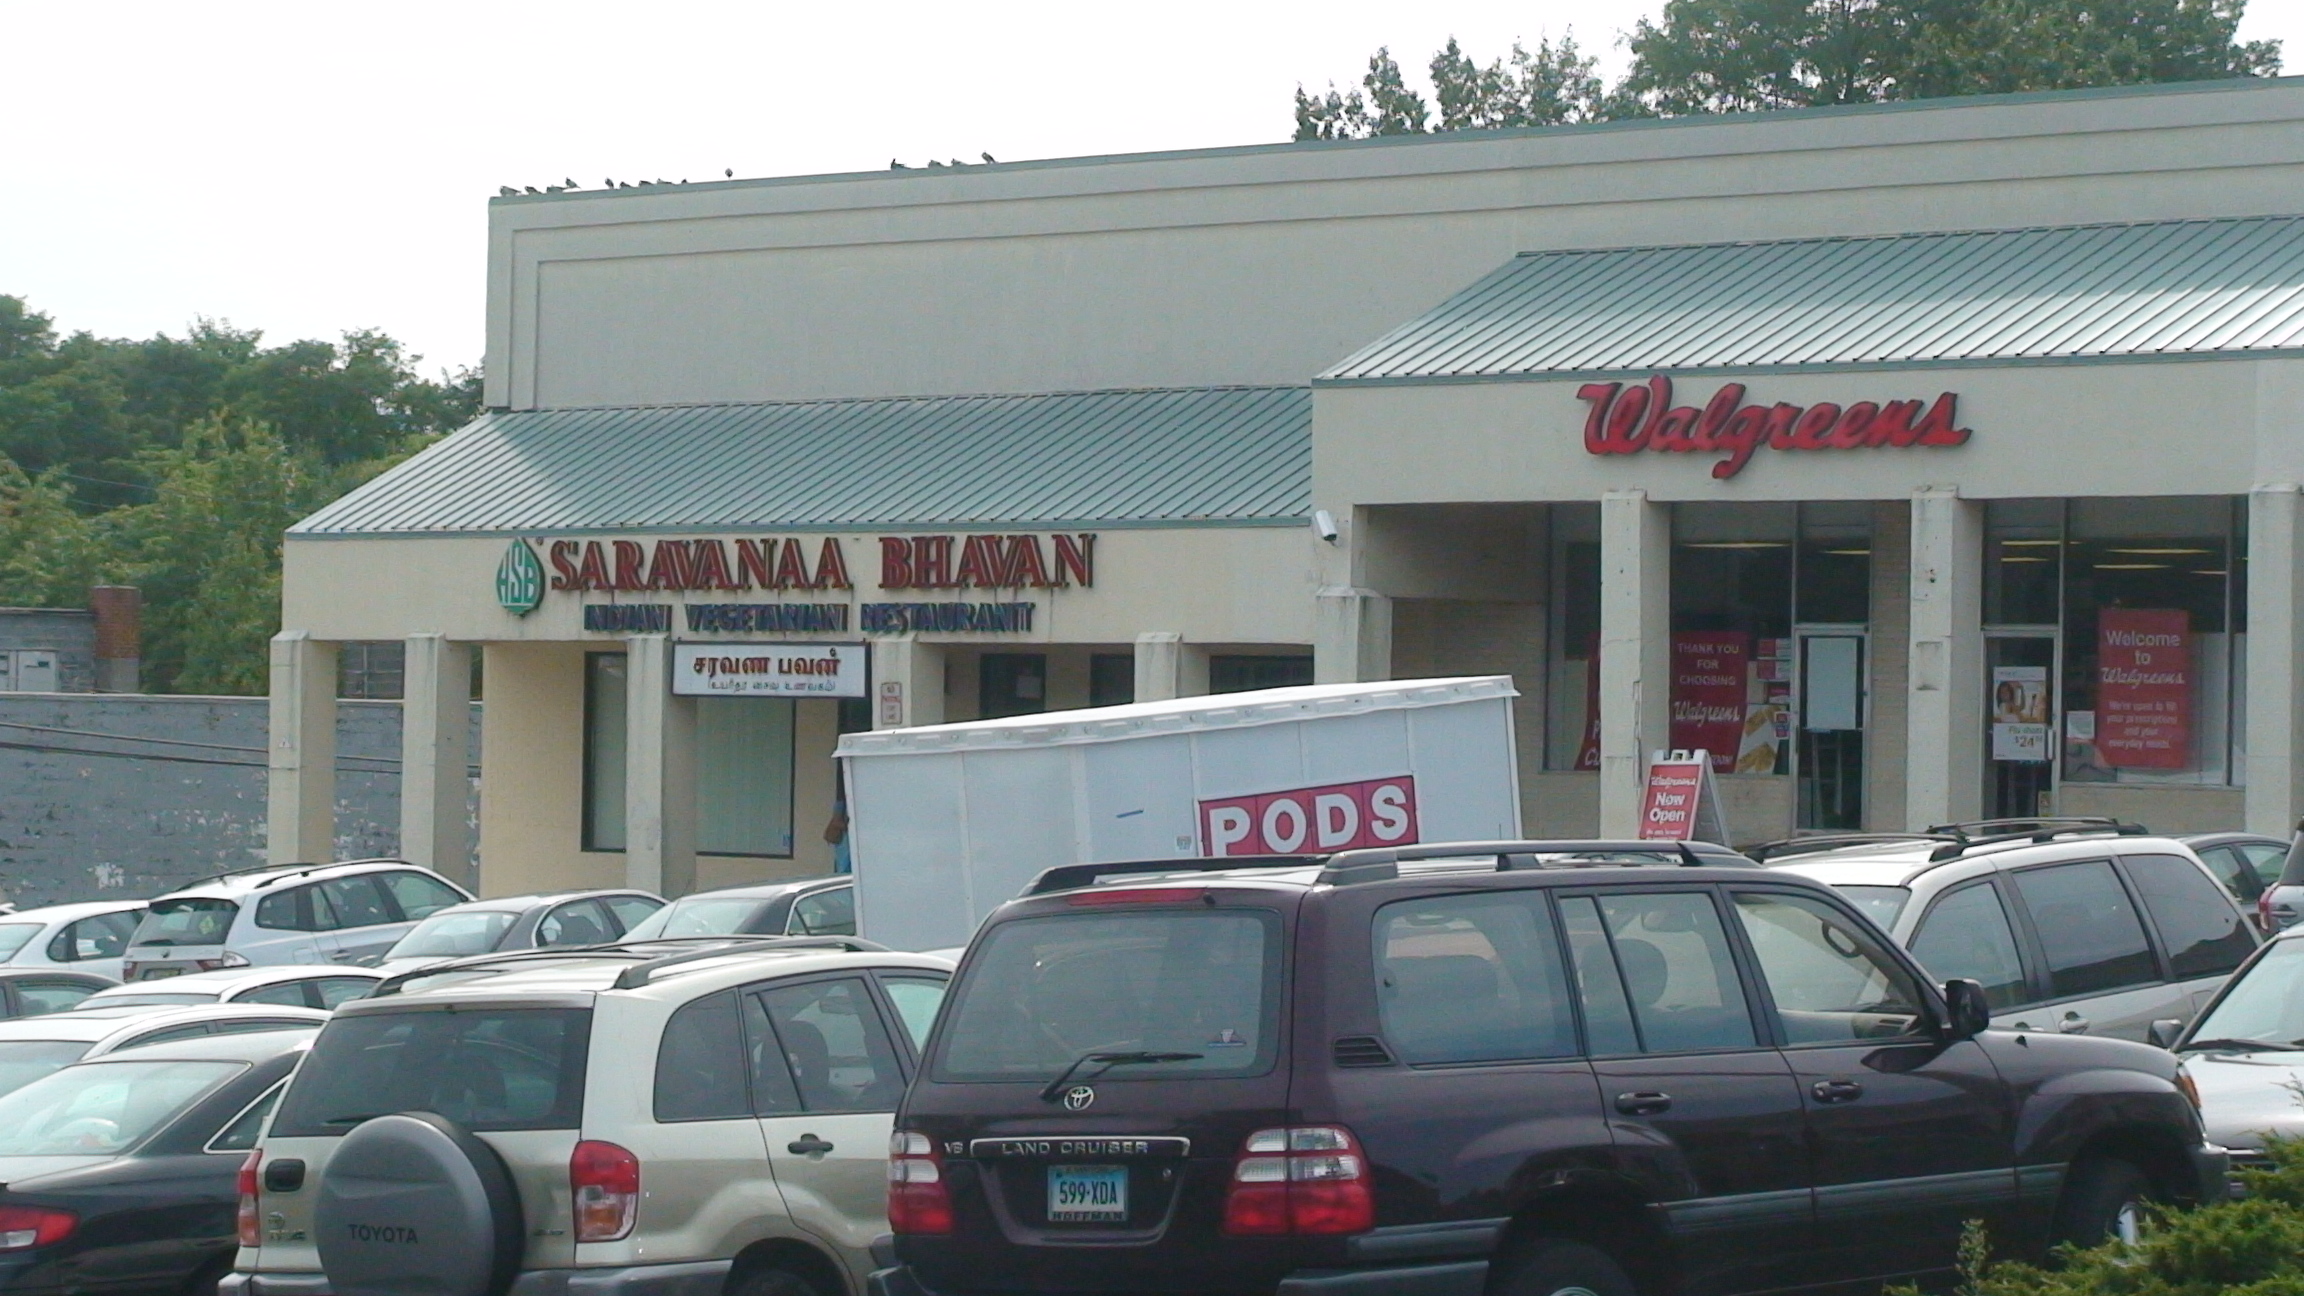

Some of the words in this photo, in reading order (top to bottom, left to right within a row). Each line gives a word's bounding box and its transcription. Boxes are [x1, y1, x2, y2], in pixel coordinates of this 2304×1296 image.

[1577, 374, 1972, 479] Walgreens
[550, 538, 852, 590] SARAVANAA
[878, 534, 1096, 588] BHAVAN
[584, 604, 672, 631] INDIAN
[685, 604, 848, 631] VEGETARIAN
[861, 603, 1035, 631] RESTAURANT
[2106, 630, 2181, 647] Welcome
[1678, 643, 1716, 654] THANK
[1717, 643, 1740, 654] YOU
[2135, 650, 2151, 665] to
[693, 656, 770, 678] சரவண
[778, 647, 841, 676] பவன்
[1697, 659, 1719, 670] FOR
[1679, 675, 1737, 686] CHOOSING
[2101, 667, 2185, 689] Walgreens
[1674, 701, 1740, 727] Walgreens
[1655, 792, 1686, 806] Now
[1209, 785, 1409, 858] PODS
[1649, 807, 1686, 825] Open
[1002, 1143, 1050, 1155] LAND
[1060, 1141, 1149, 1155] CRUISER
[1052, 1211, 1124, 1221] HOFFMAN
[347, 1223, 419, 1244] TOYOTA
